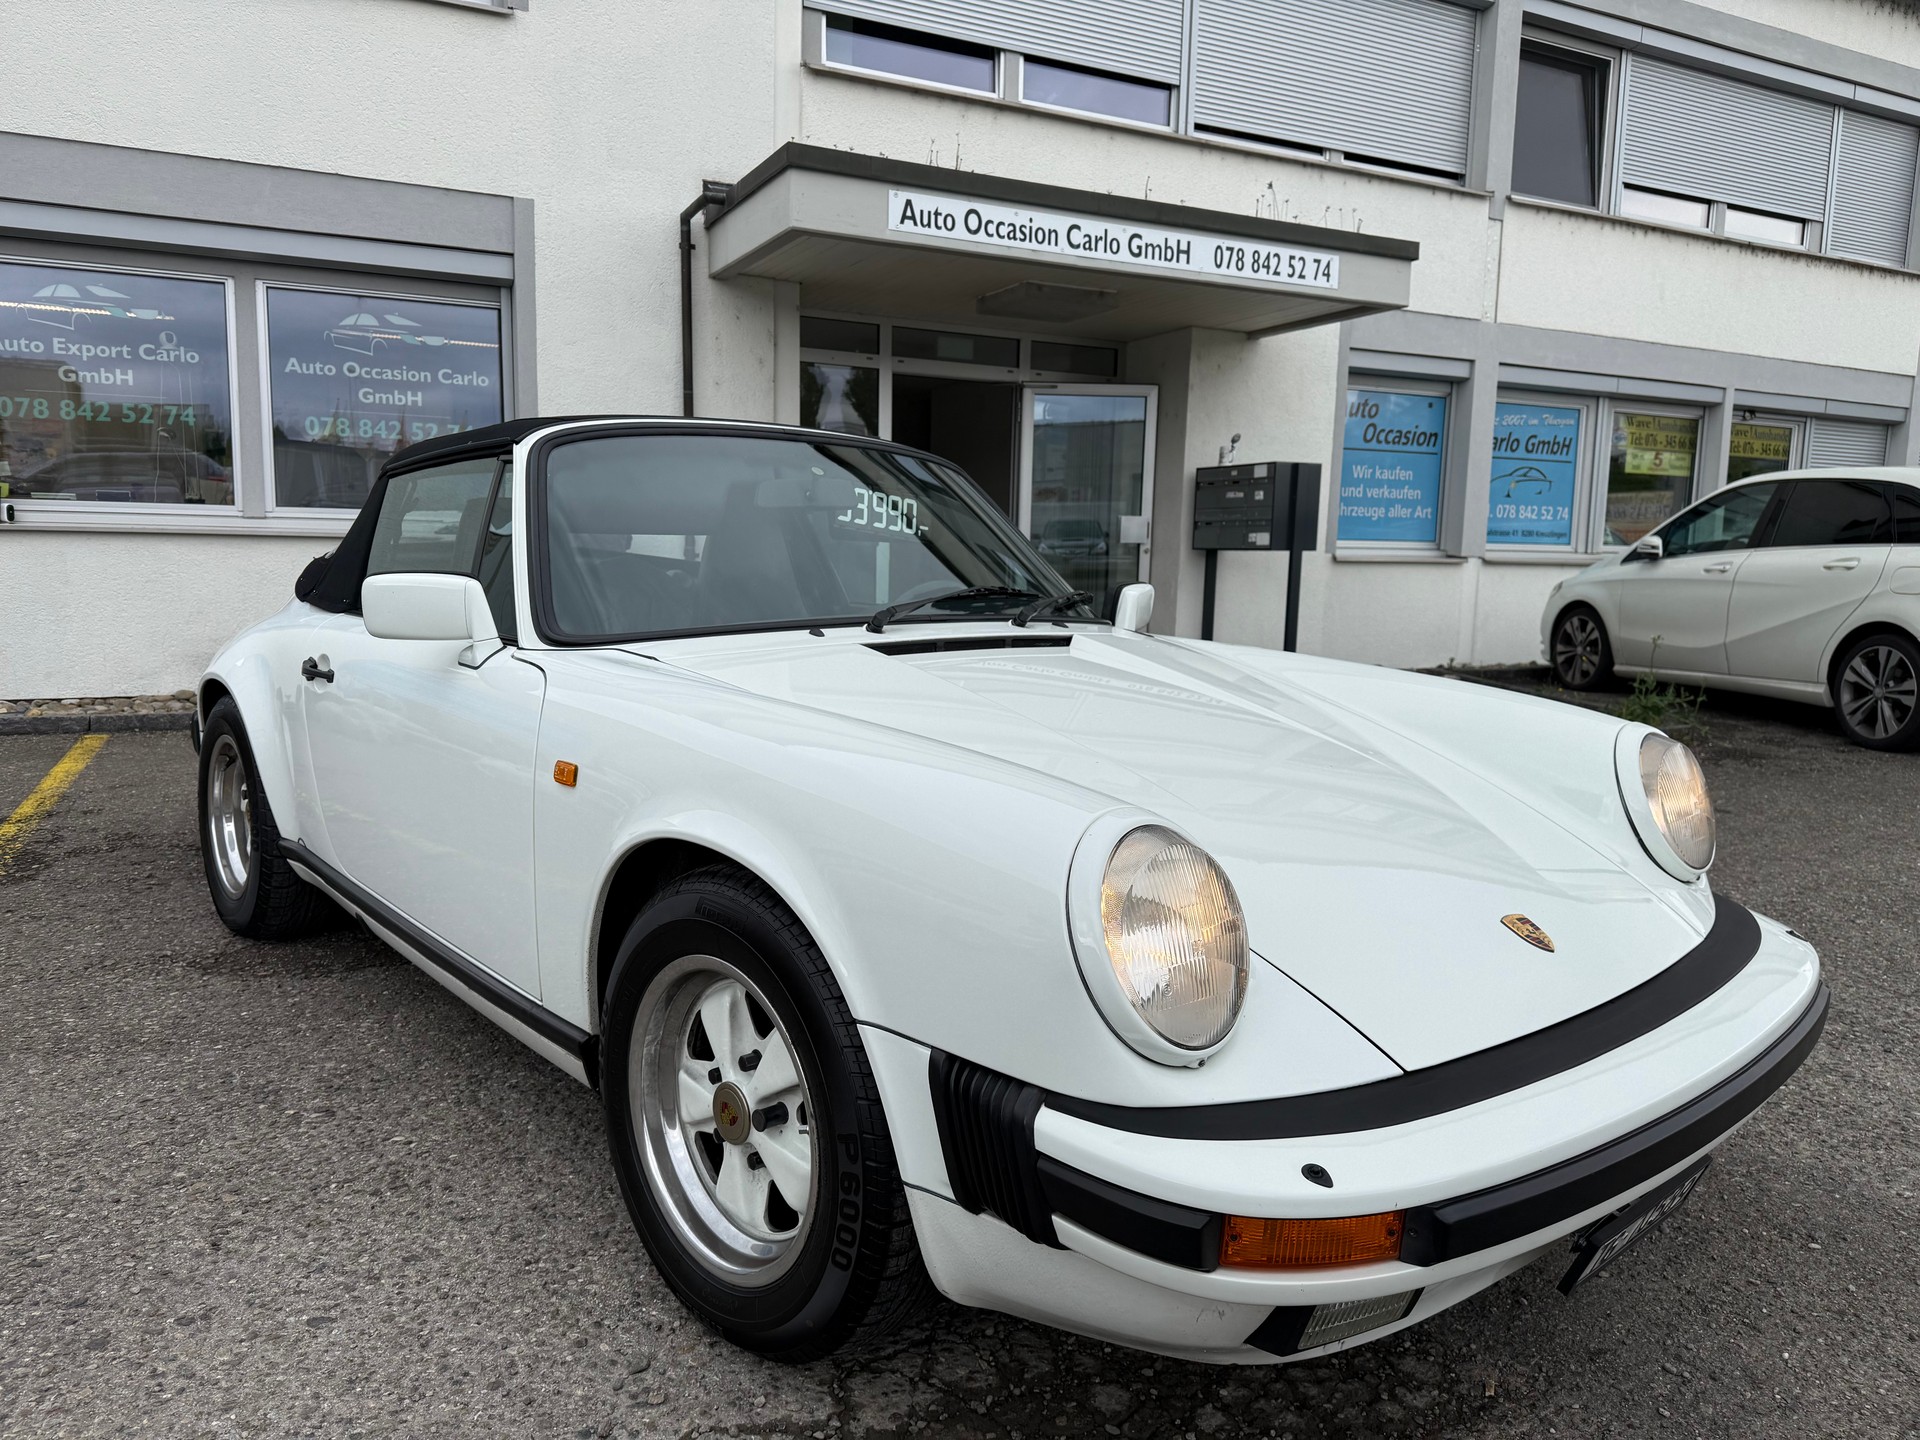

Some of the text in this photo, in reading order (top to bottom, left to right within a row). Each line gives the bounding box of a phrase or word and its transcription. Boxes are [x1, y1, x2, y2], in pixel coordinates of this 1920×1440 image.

[899, 198, 1332, 283] Auto Occasion Carlo GmbH 078 842 52 74
[0, 337, 200, 364] uto Export Carlo
[58, 365, 134, 386] GmbH
[284, 357, 490, 387] Auto Occasion Carlo
[358, 388, 423, 407] GmbH
[0, 396, 197, 427] 078 842 52 74
[1344, 398, 1380, 419] uto
[304, 415, 350, 437] 078
[358, 418, 402, 440] 842
[1502, 414, 1527, 426] 2007
[1362, 422, 1439, 448] Occasion
[1492, 431, 1573, 456] arlo GmbH
[1653, 451, 1663, 468] 5
[1352, 464, 1413, 481] Wir kaufen
[1341, 483, 1422, 500] und verkaufen
[1340, 501, 1432, 521] hrzeuge aller Art
[1496, 504, 1517, 519] 078
[1518, 504, 1539, 520] 842
[1540, 506, 1554, 520] 52
[1556, 506, 1570, 521] 74
[831, 1171, 861, 1272] 6000
